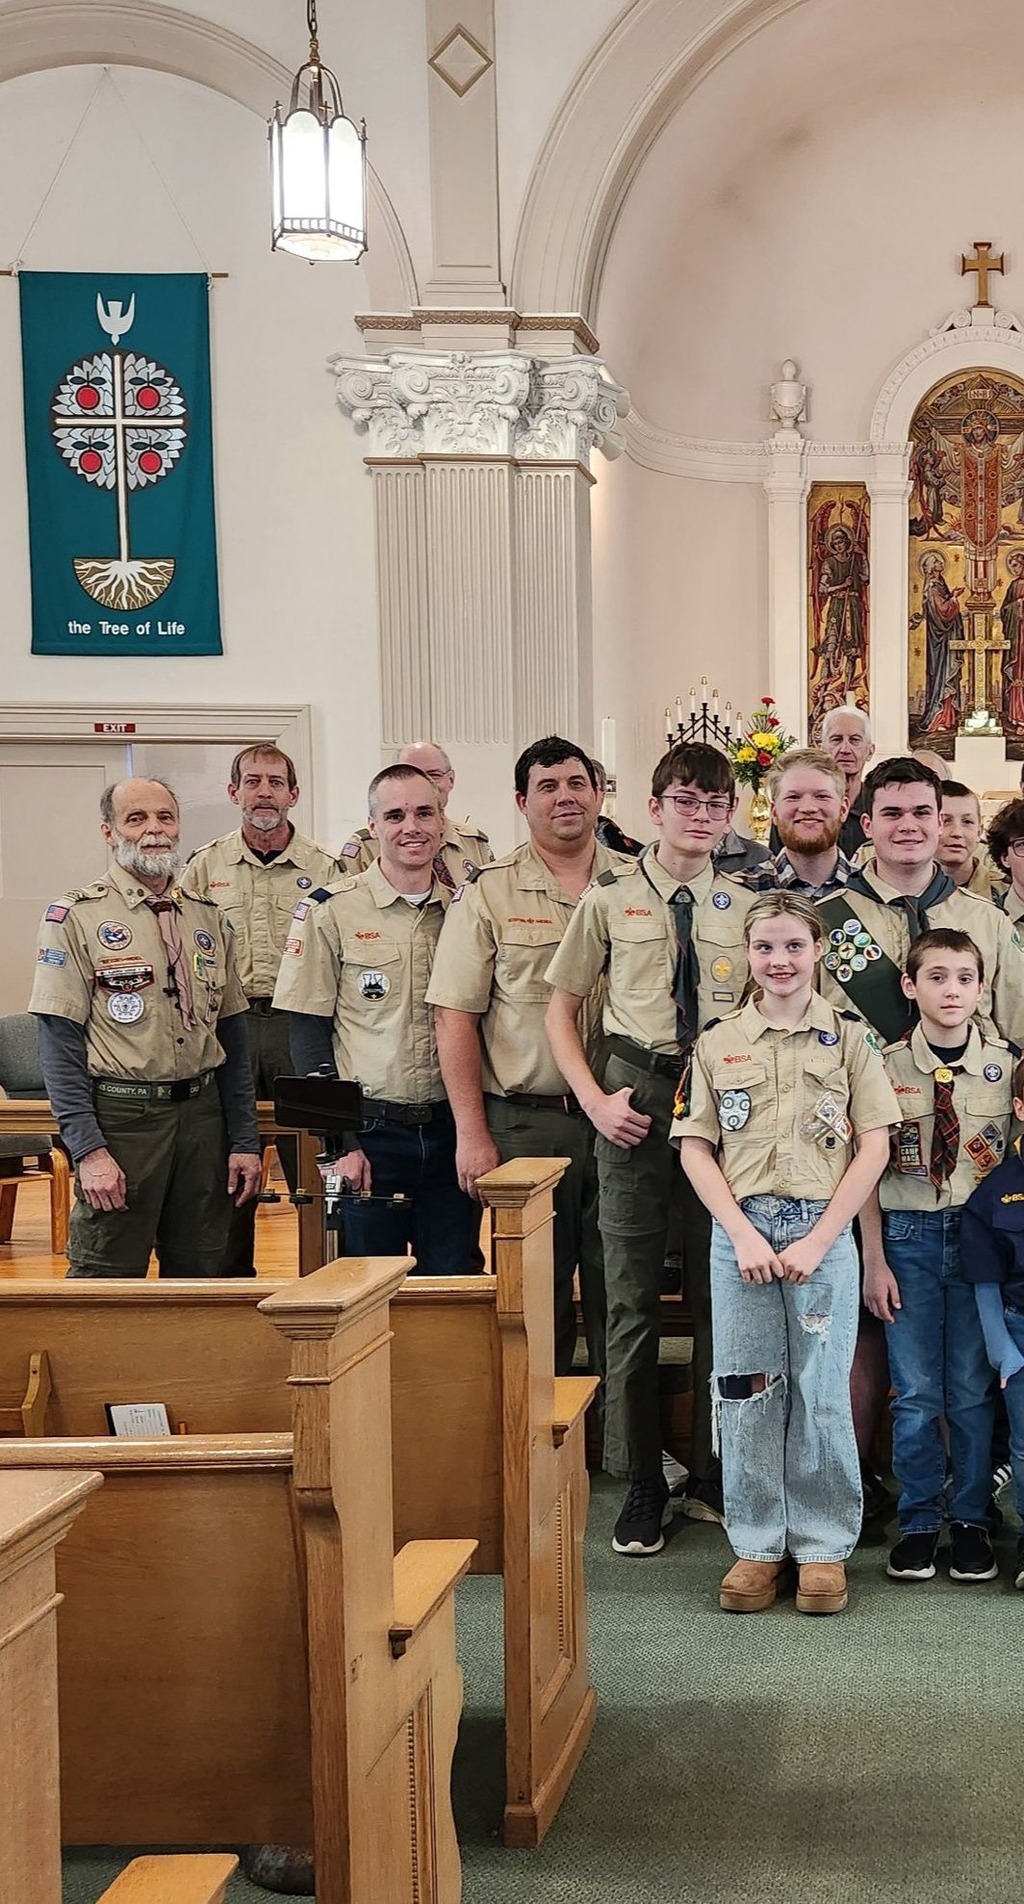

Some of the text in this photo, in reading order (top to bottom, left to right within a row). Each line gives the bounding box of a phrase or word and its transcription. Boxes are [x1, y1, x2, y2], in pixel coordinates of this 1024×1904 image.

[68, 621, 185, 635] the Tree of Life
[103, 724, 127, 732] EXIT
[734, 1055, 752, 1063] BSA
[107, 1086, 137, 1095] COUNTY,
[138, 1086, 147, 1095] PA
